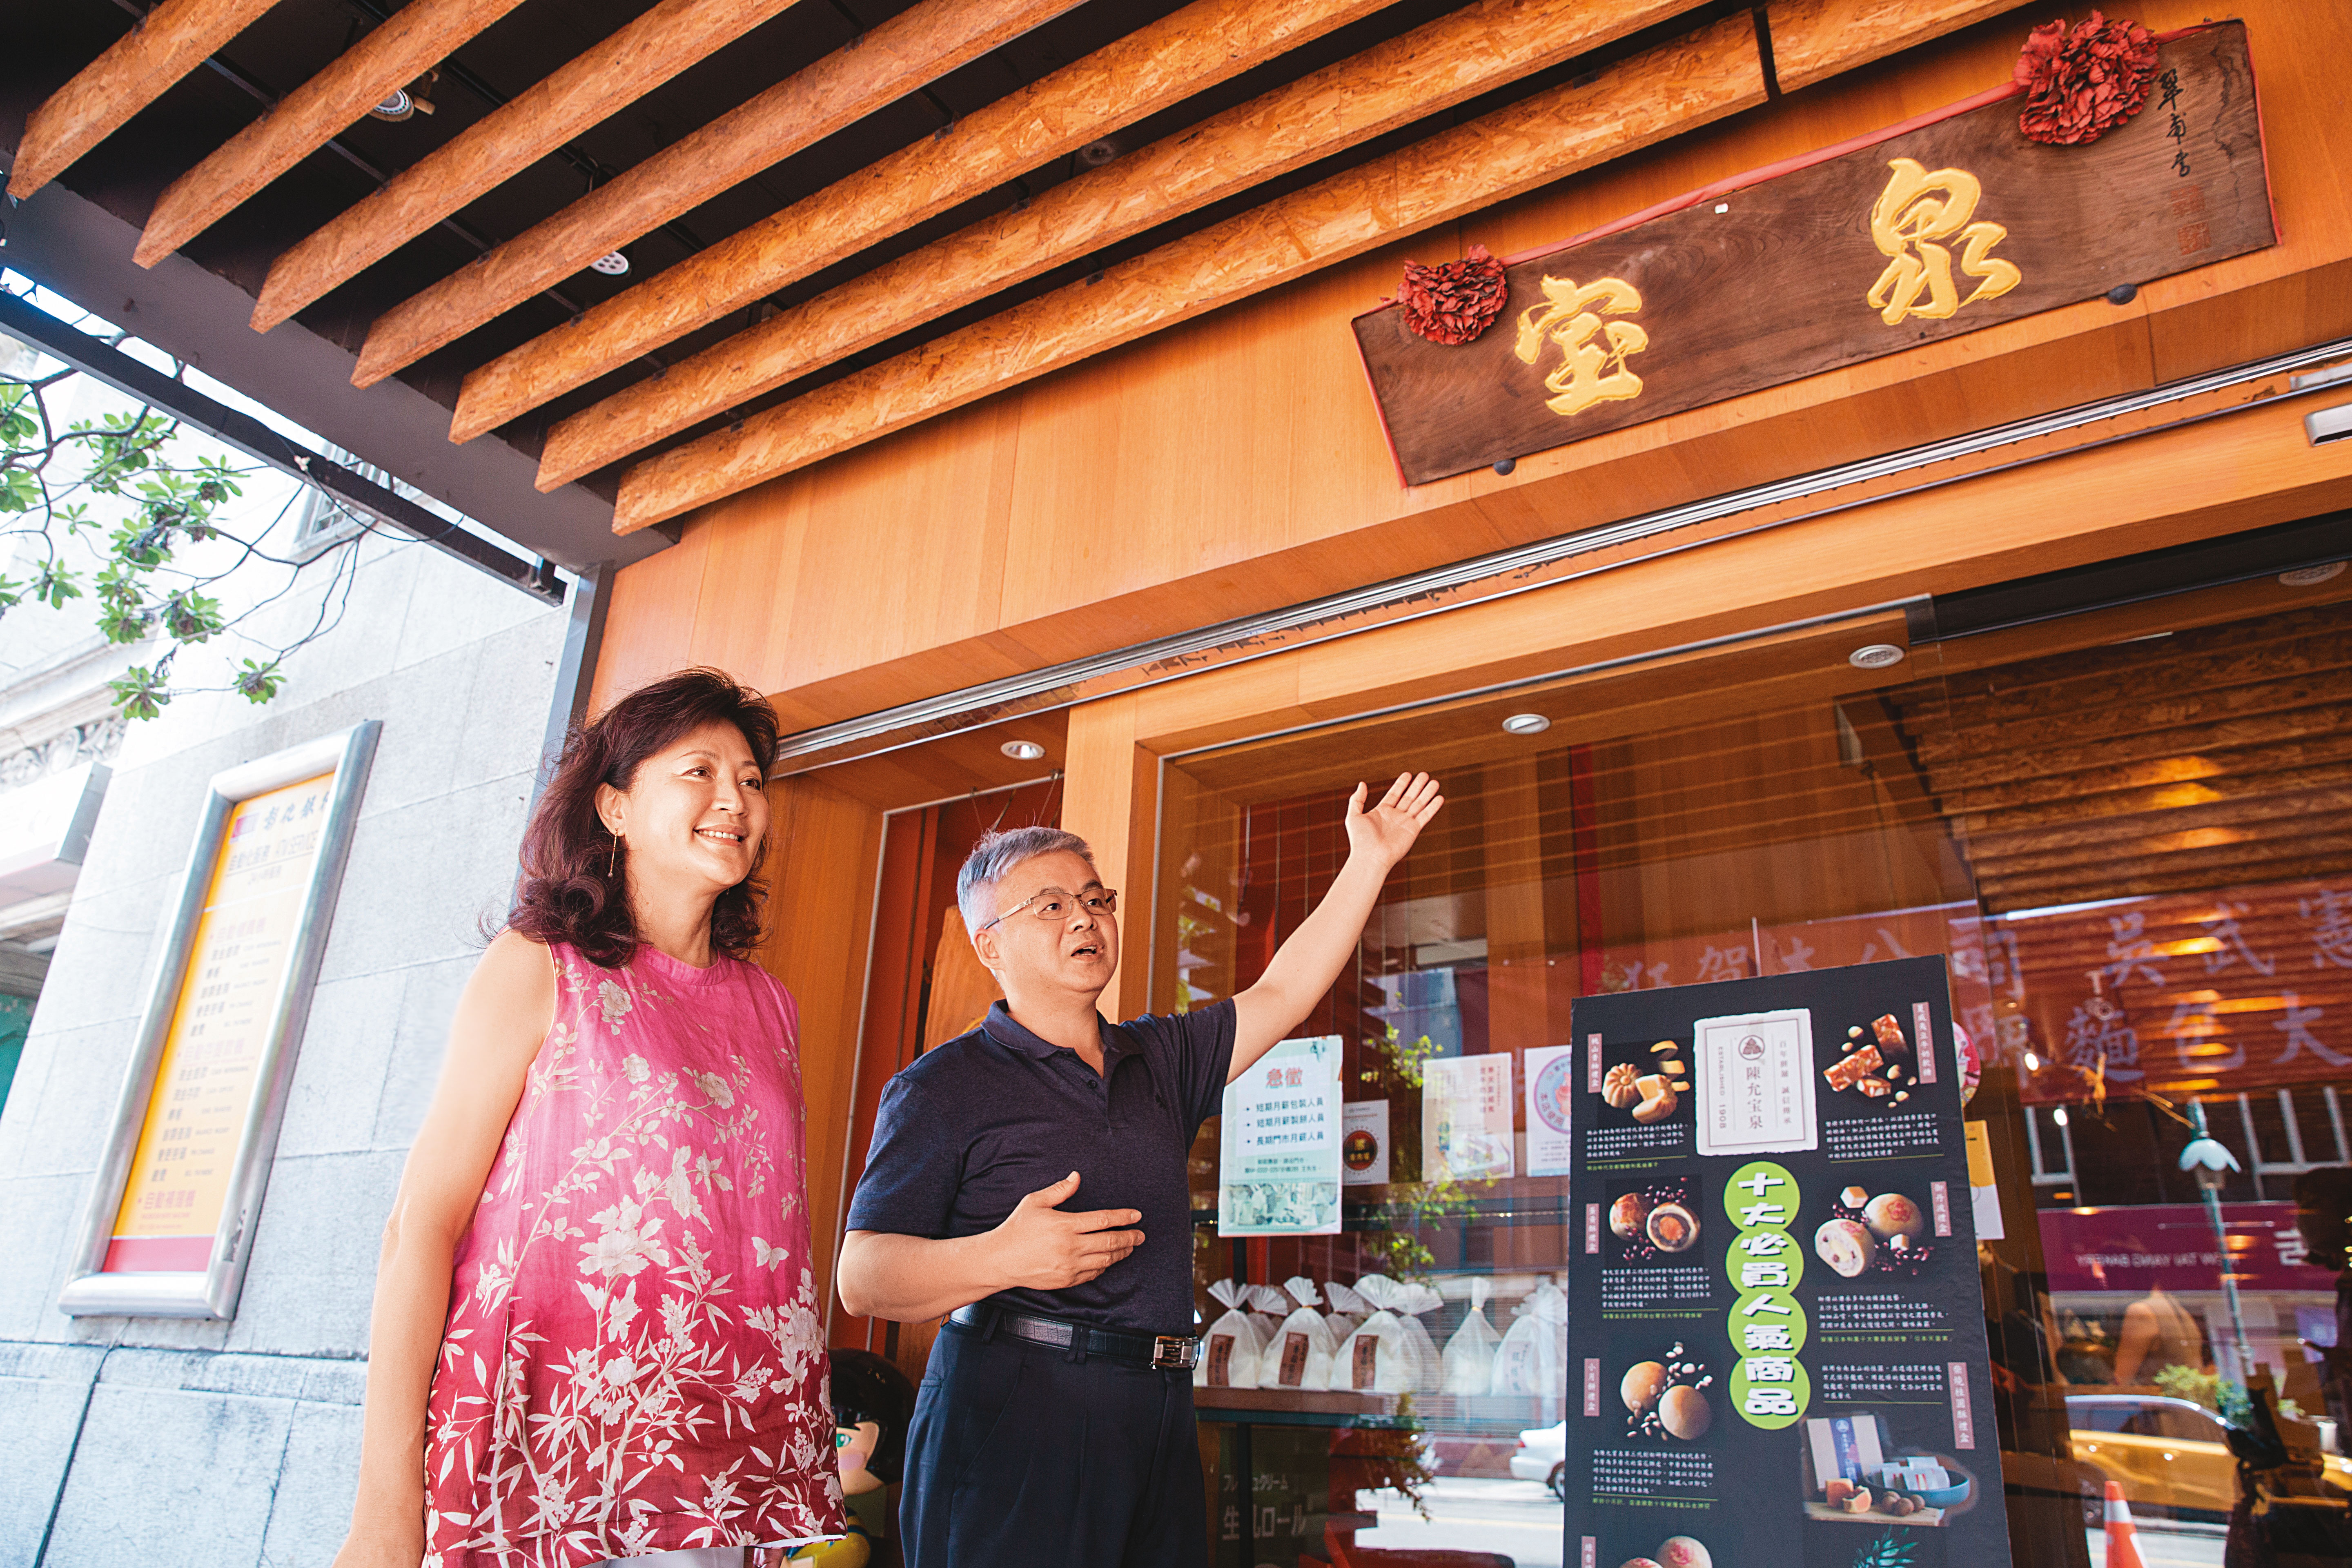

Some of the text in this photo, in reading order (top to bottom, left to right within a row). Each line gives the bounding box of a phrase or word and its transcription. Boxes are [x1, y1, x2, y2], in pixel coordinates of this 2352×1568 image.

[1917, 1004, 1931, 1076] 夏威夷豆牛奶軟糖
[1266, 1067, 1303, 1088] 急徵
[1745, 1066, 1763, 1129] 陳允宝泉
[1256, 1097, 1323, 1113] 短期月薪包裝人員
[1718, 1104, 1727, 1129] 1908
[1256, 1131, 1324, 1146] 長期門市月薪人員
[1934, 1184, 1948, 1232] 御丹波禮盒
[1737, 1172, 1797, 1415] 十大必買人氣商品
[1588, 1363, 1596, 1411] 小月餅禮盒
